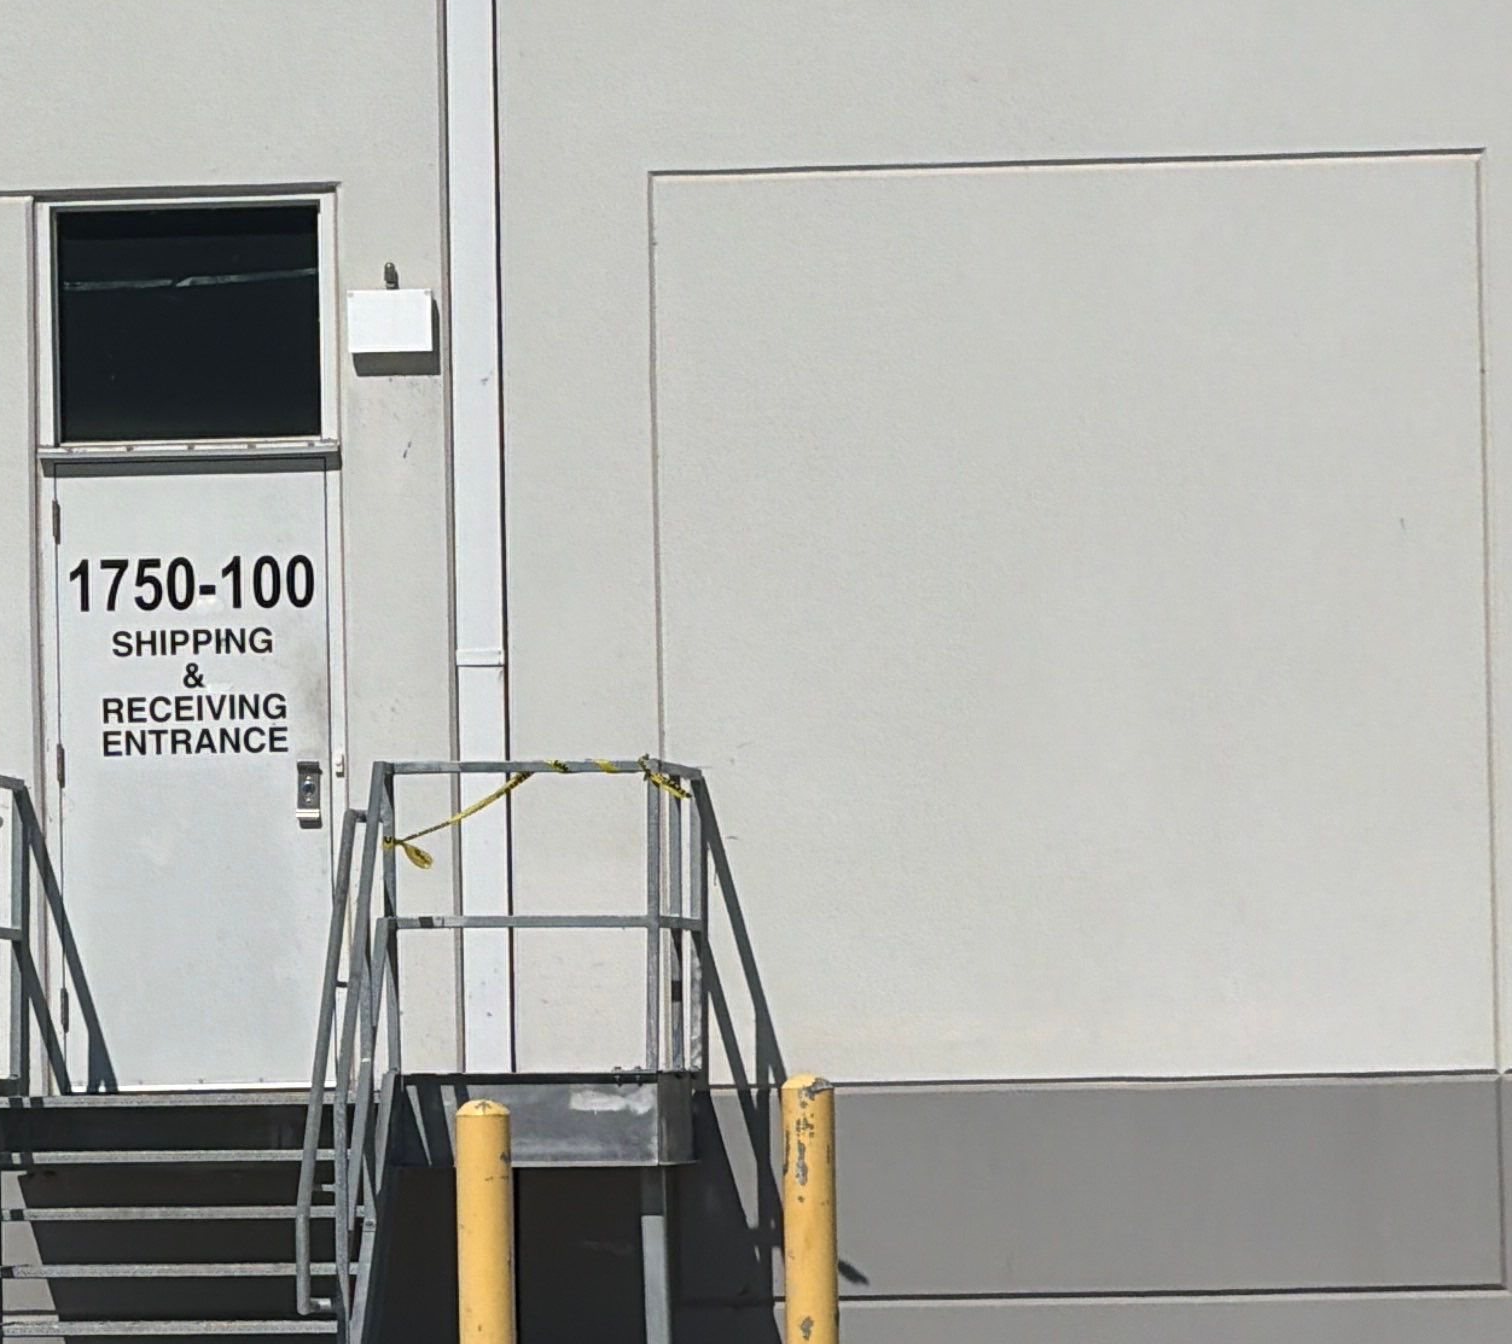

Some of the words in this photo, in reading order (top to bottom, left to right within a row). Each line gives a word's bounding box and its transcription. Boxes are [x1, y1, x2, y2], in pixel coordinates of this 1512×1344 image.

[69, 554, 315, 613] 1750-100
[112, 626, 274, 658] SHIPPING
[183, 662, 205, 689] &
[102, 693, 288, 724] RECEIVING
[102, 726, 289, 757] ENTRANCE
